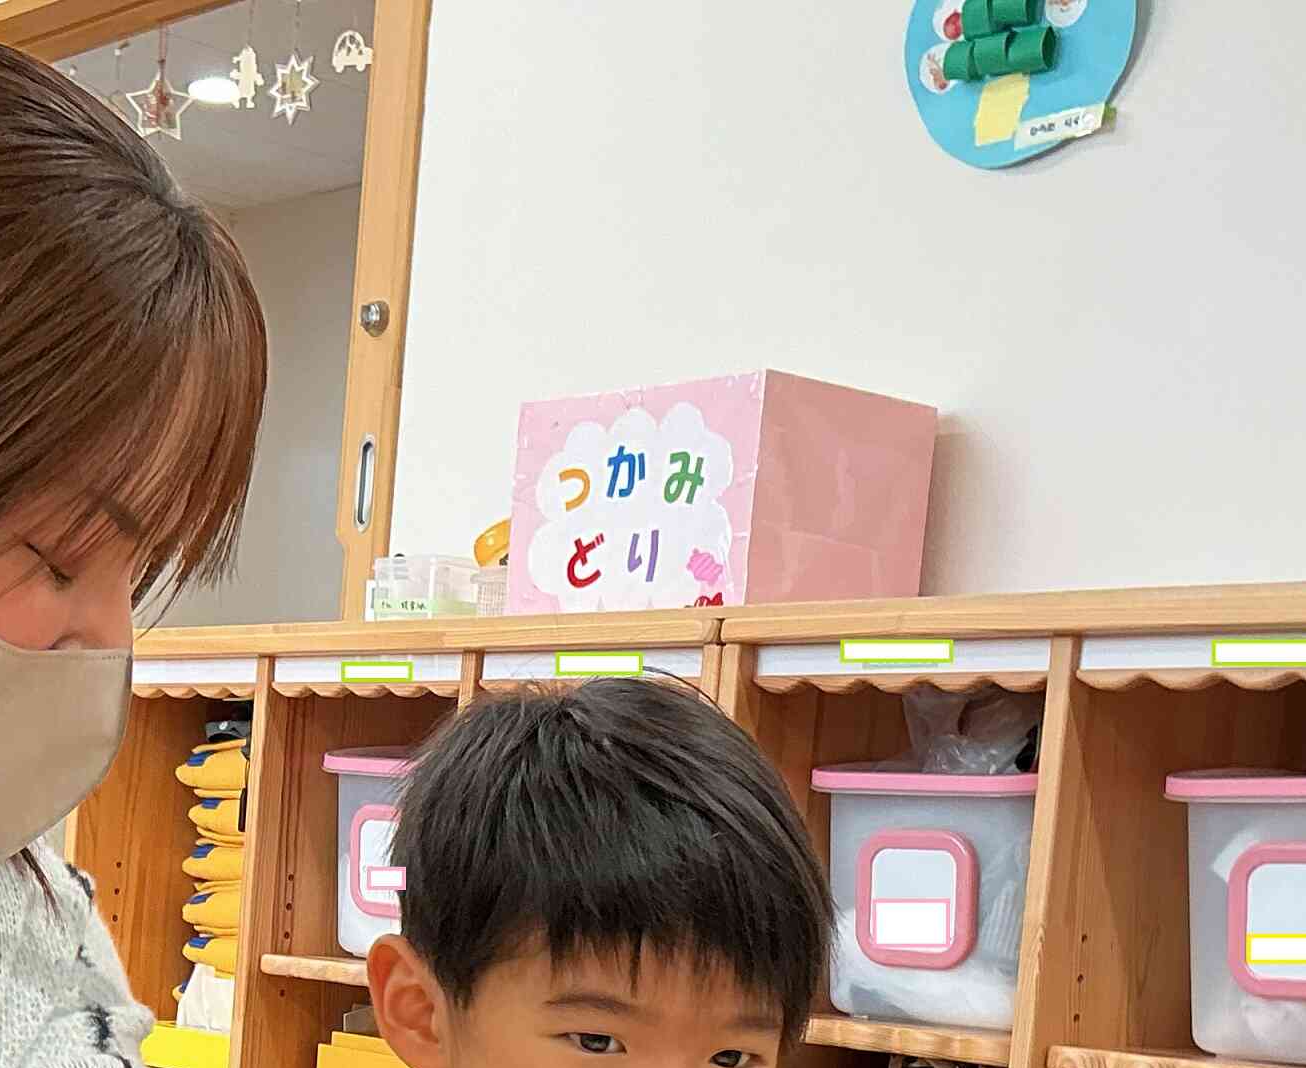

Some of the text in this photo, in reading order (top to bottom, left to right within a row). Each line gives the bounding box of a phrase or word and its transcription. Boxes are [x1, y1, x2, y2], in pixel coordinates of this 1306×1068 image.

[557, 443, 706, 513] つかみ
[565, 528, 660, 589] どり
